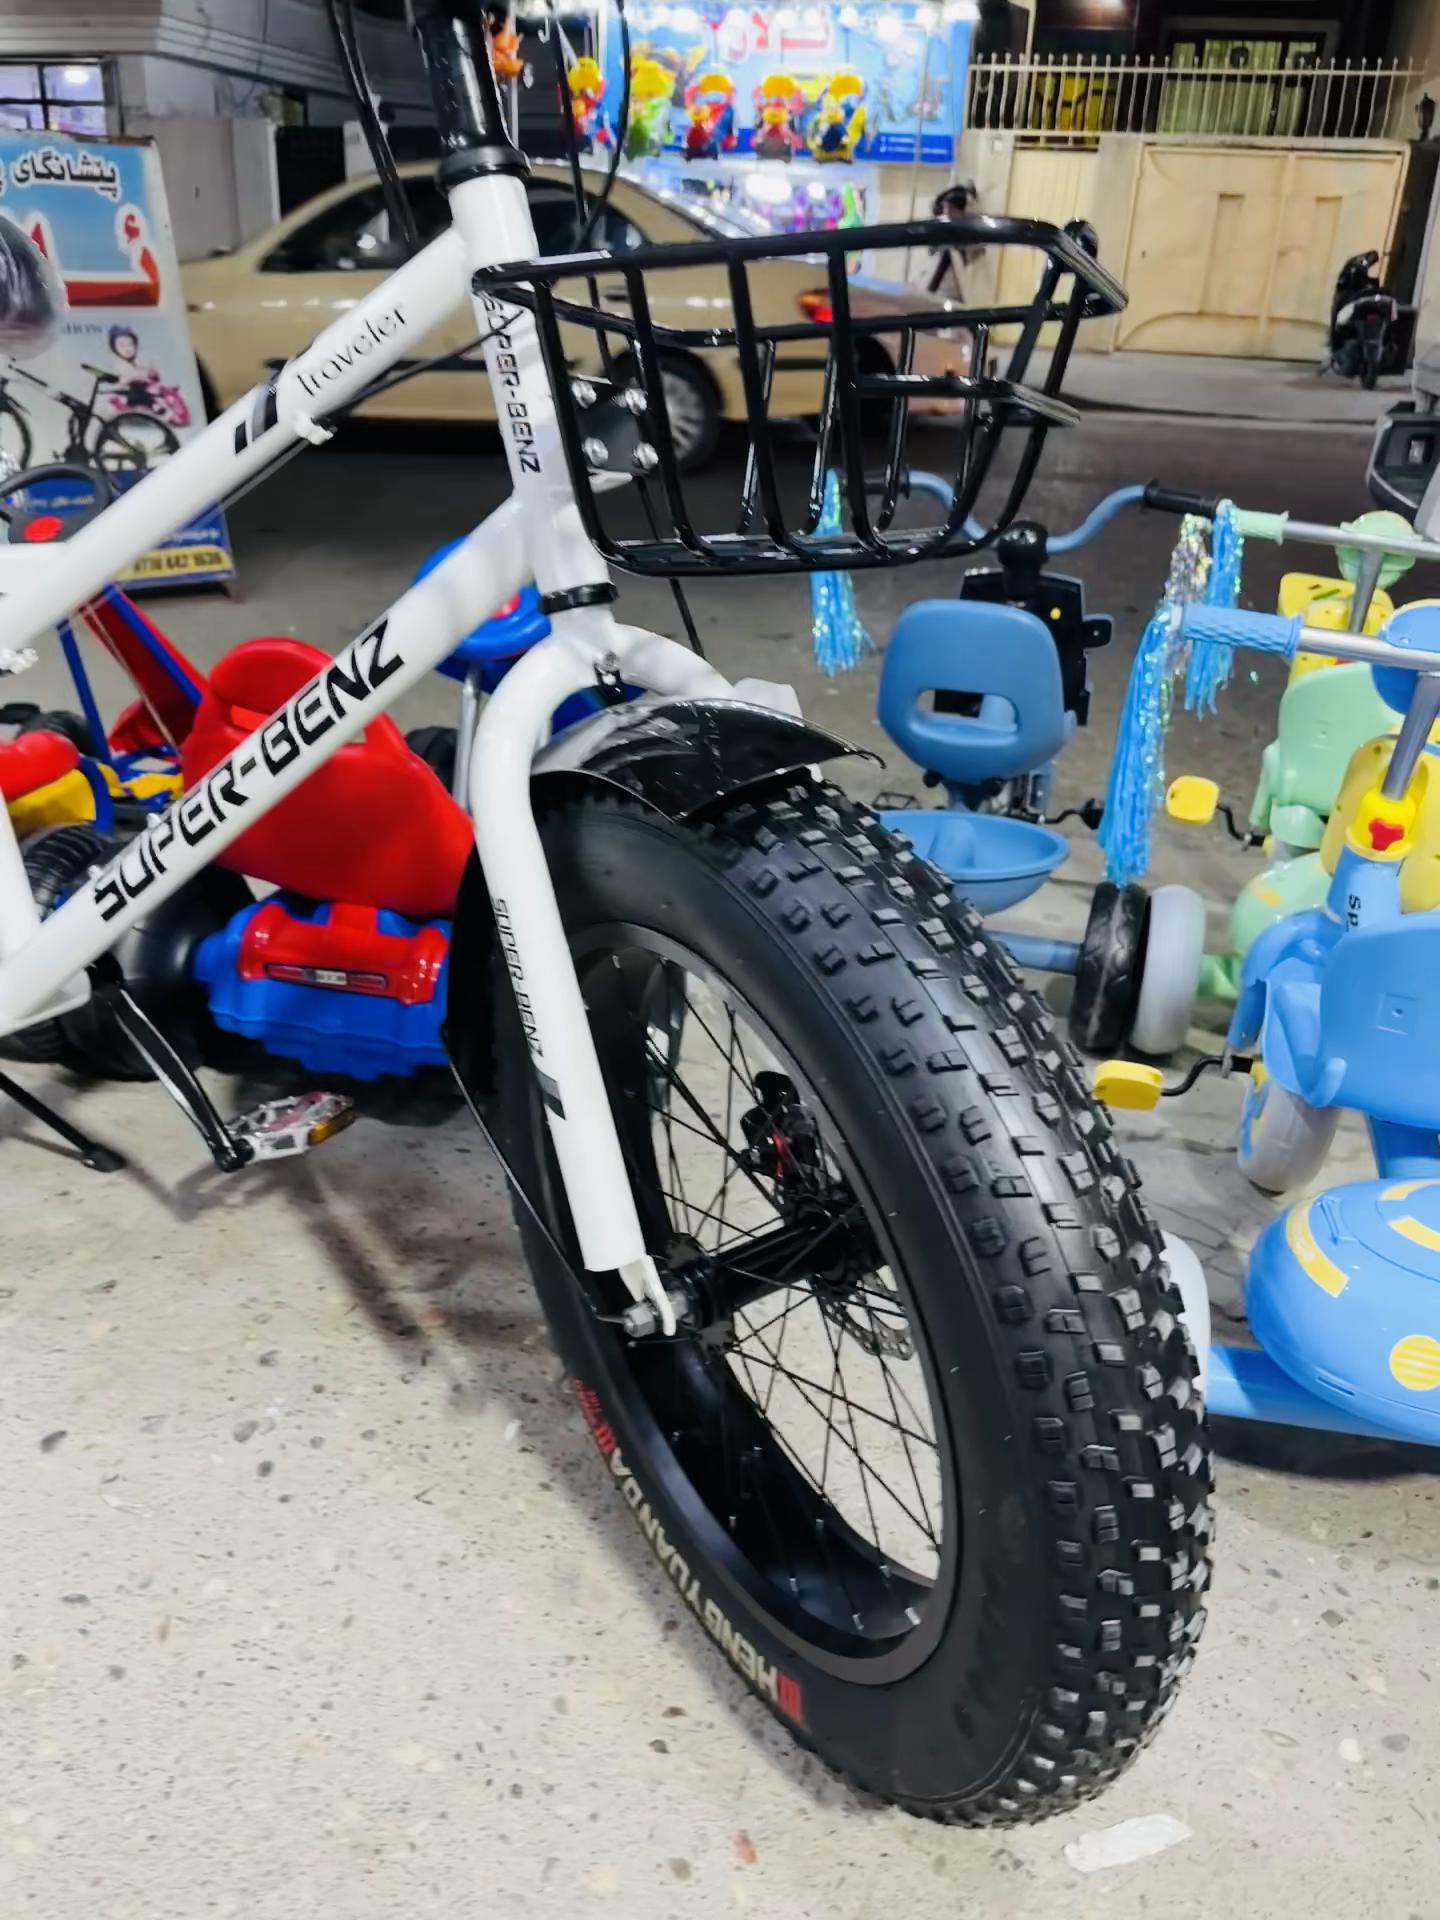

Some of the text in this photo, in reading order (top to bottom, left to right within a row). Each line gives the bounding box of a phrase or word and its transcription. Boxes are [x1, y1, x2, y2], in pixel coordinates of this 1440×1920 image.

[296, 305, 405, 397] Traveler
[483, 294, 541, 474] SUPER-BENZ
[94, 617, 405, 921] SUPER-BENZ
[492, 897, 544, 1058] SUPER-BENZ
